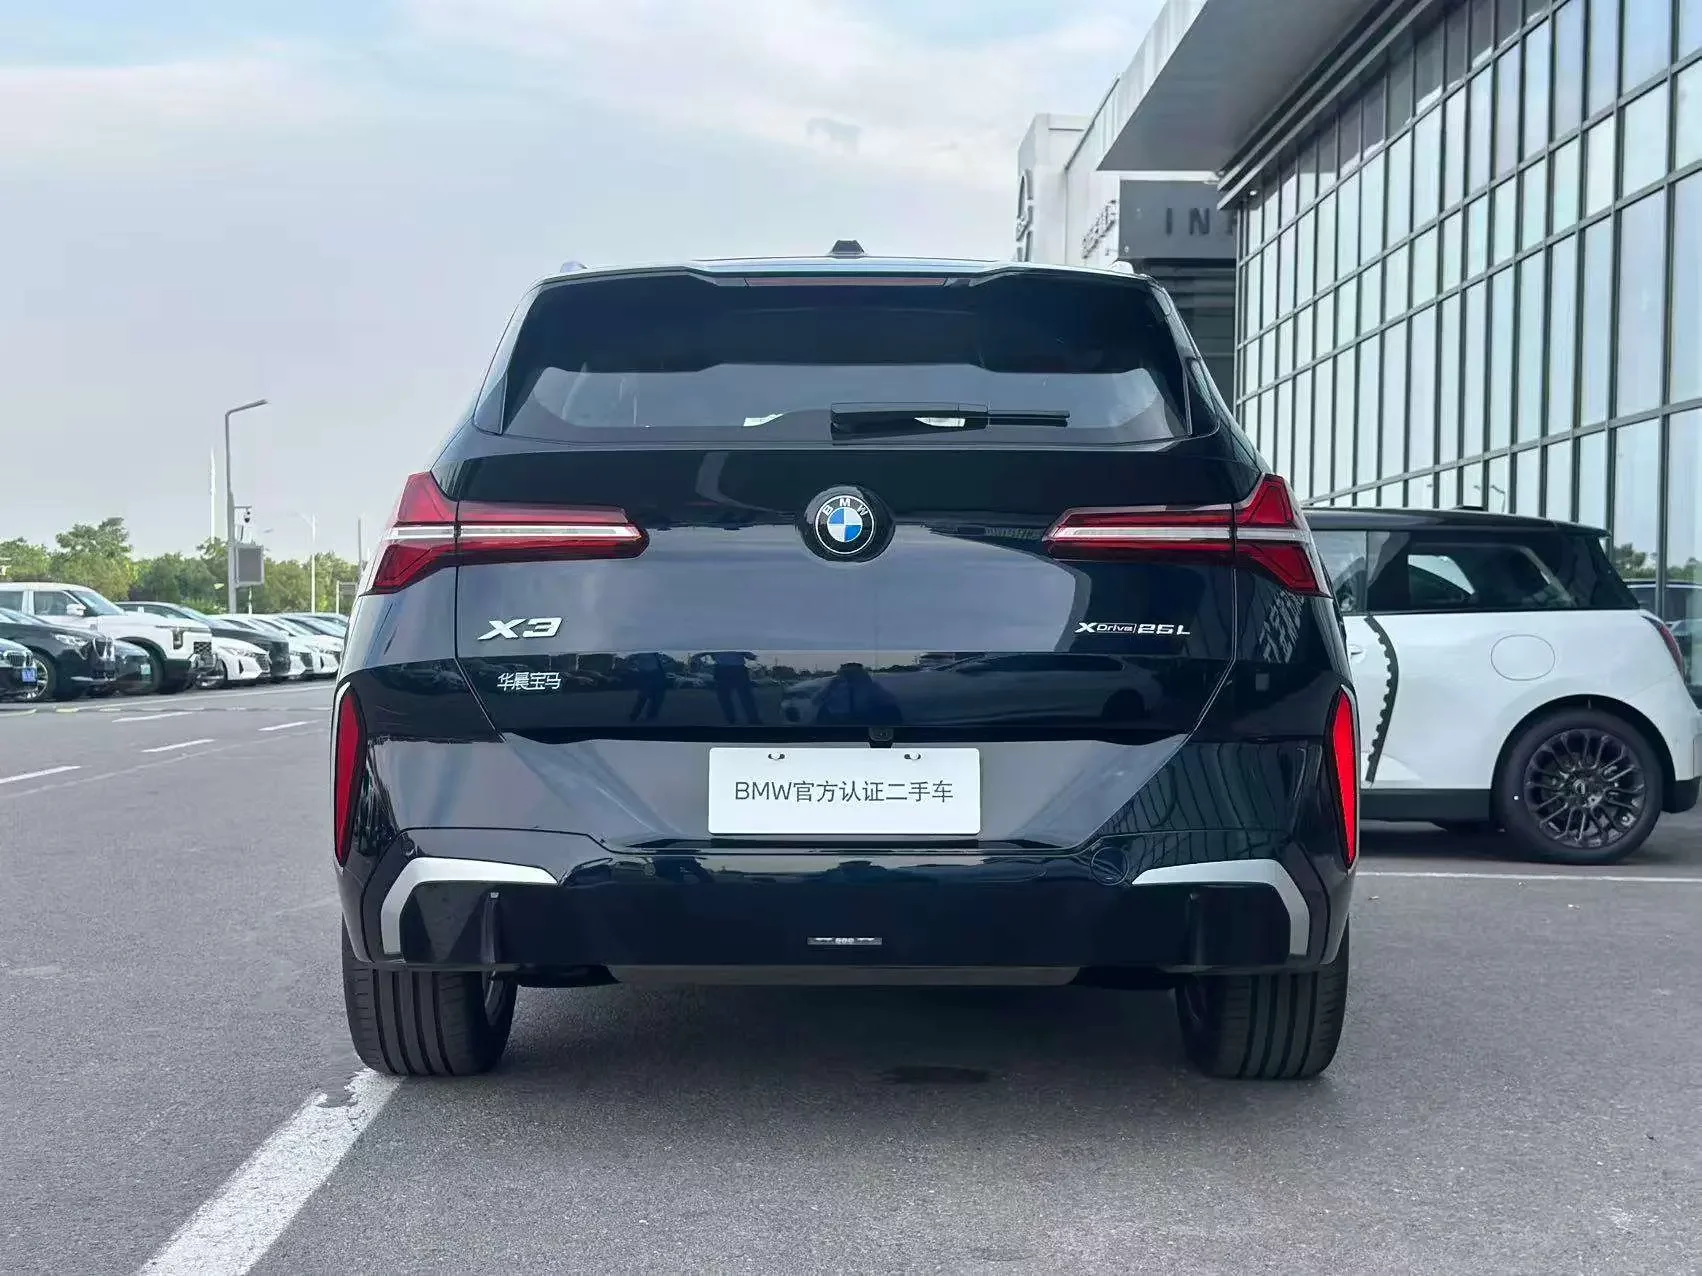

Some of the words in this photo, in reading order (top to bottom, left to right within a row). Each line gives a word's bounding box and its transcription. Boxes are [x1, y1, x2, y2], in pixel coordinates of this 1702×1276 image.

[822, 498, 869, 516] BMW
[478, 618, 563, 640] X3
[497, 672, 561, 691] 华晨宝马
[735, 780, 954, 802] BMW官方认证二手车
